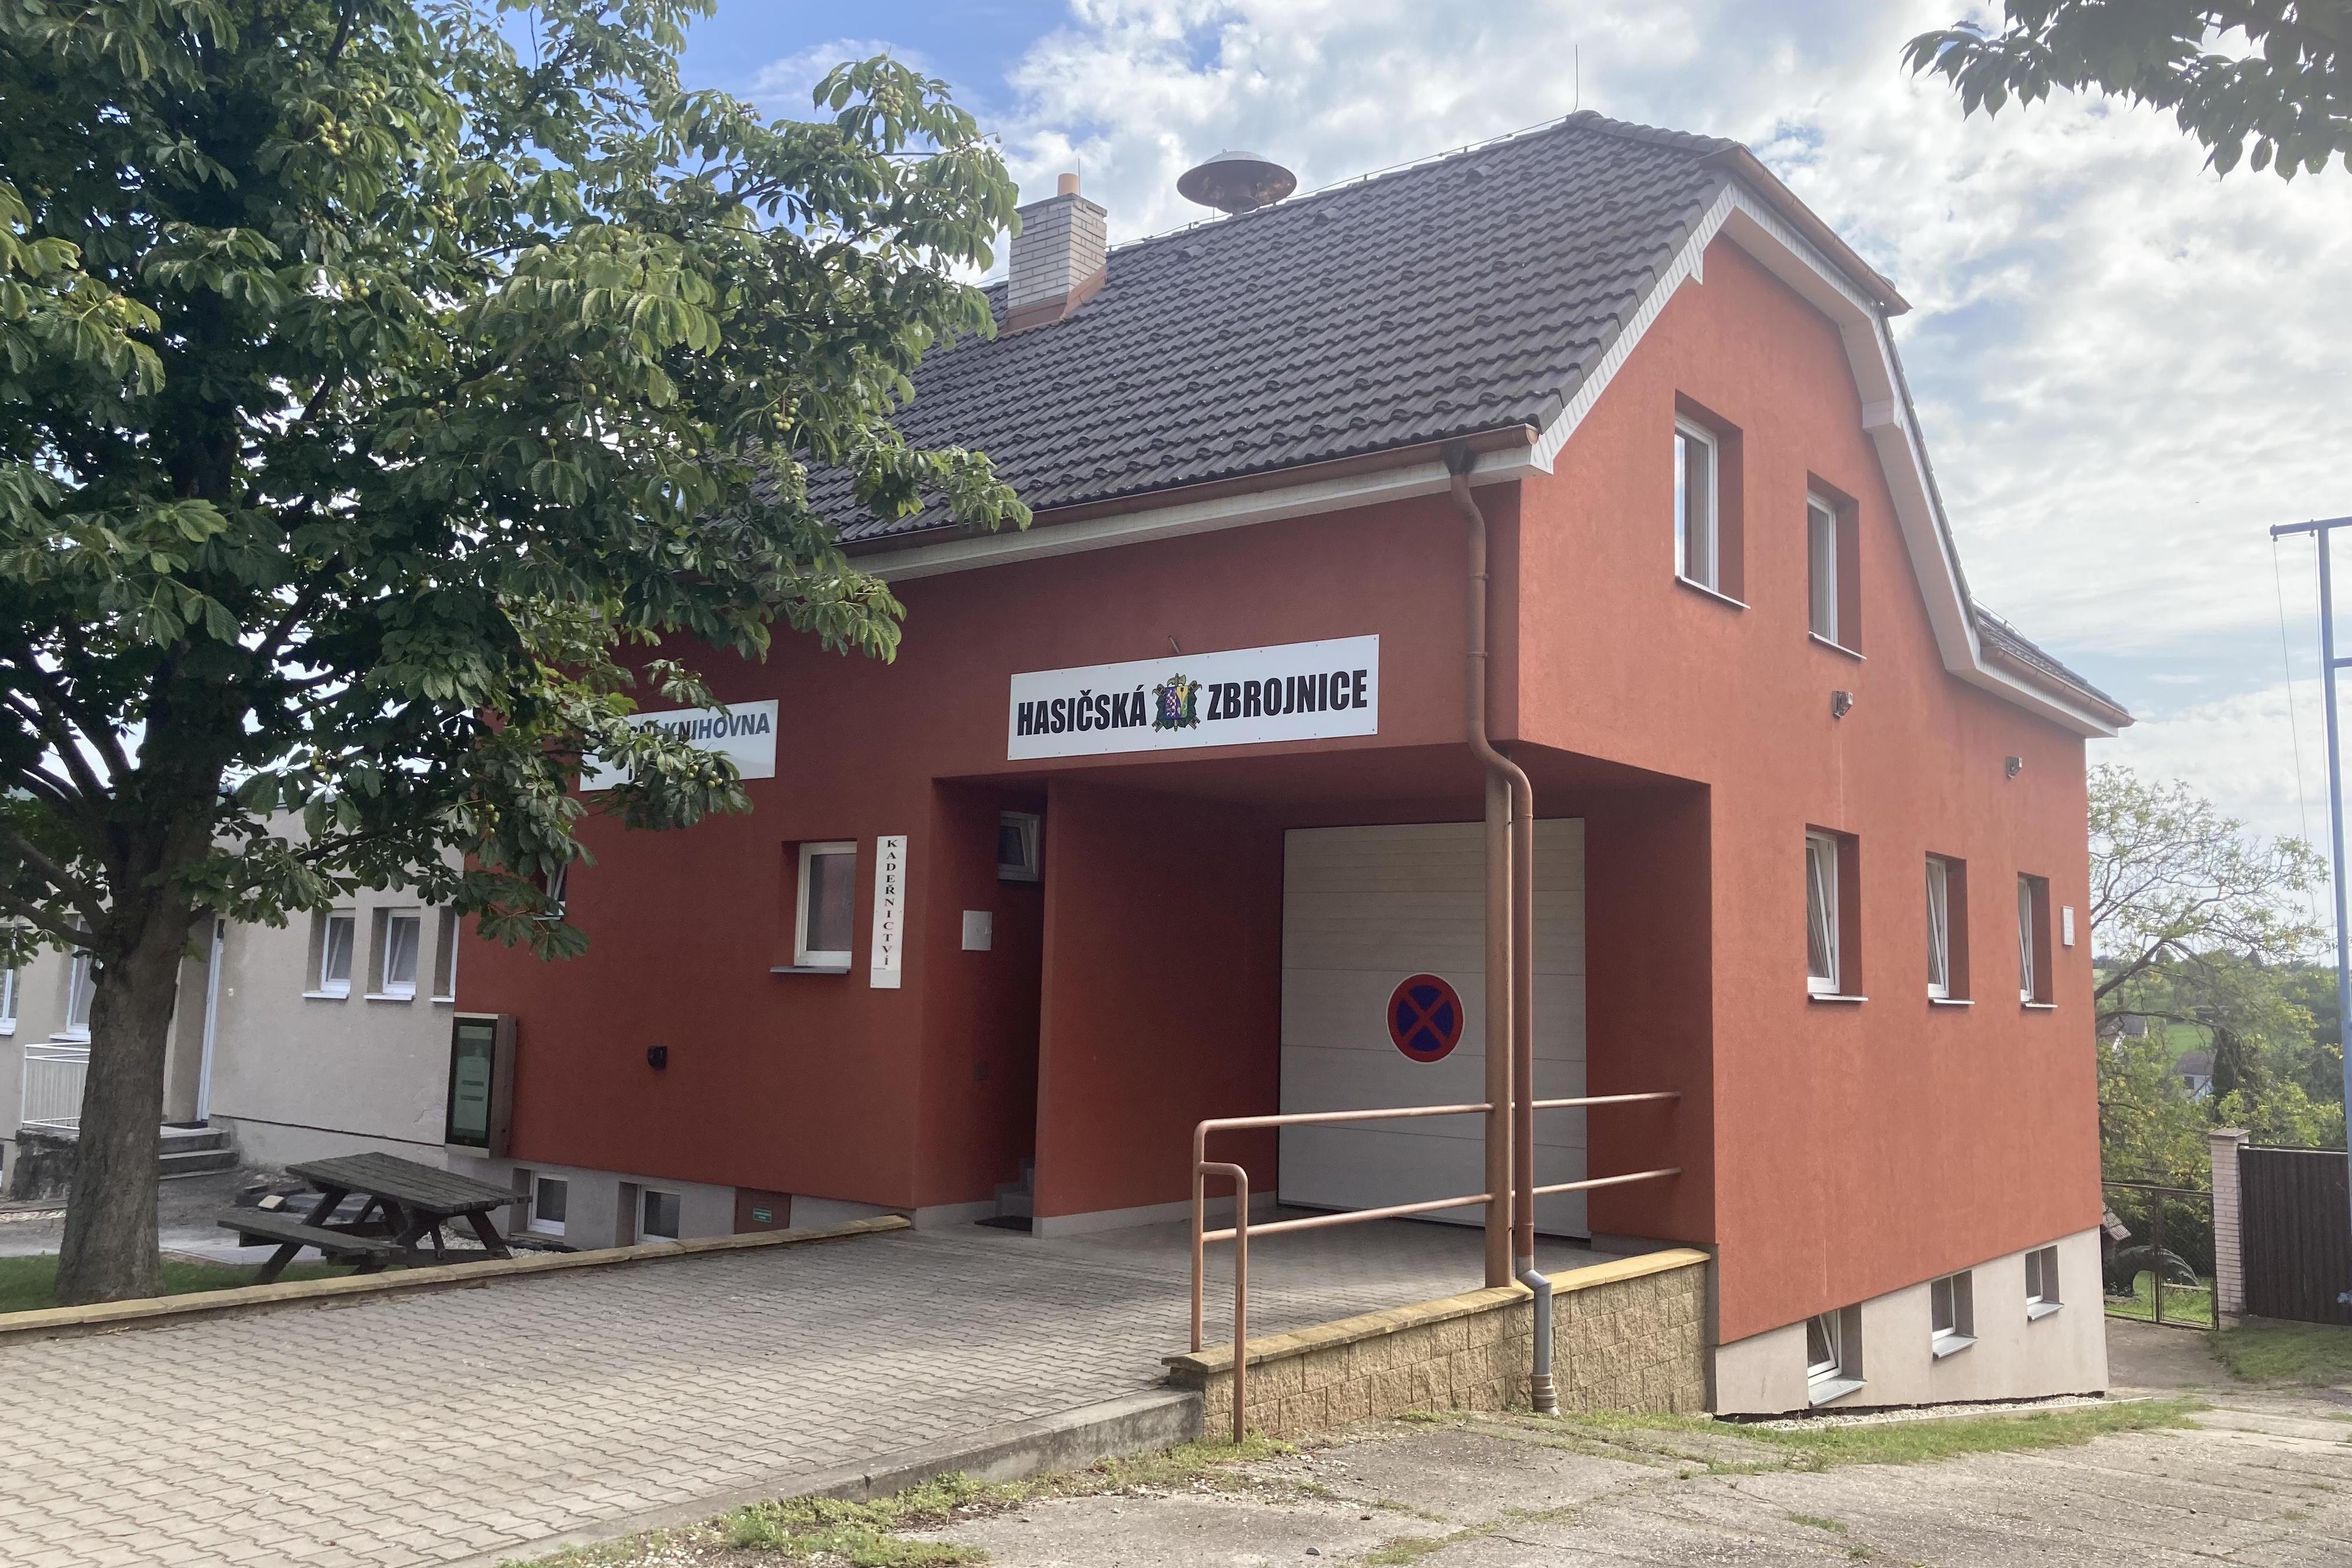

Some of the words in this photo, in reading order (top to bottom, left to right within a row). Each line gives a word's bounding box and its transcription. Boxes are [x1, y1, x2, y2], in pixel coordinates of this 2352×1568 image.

[1017, 684, 1147, 737] HASIČSKÁ
[1207, 669, 1368, 721] ZBROJNICE
[882, 839, 898, 965] KADEŘNICTVÍ
